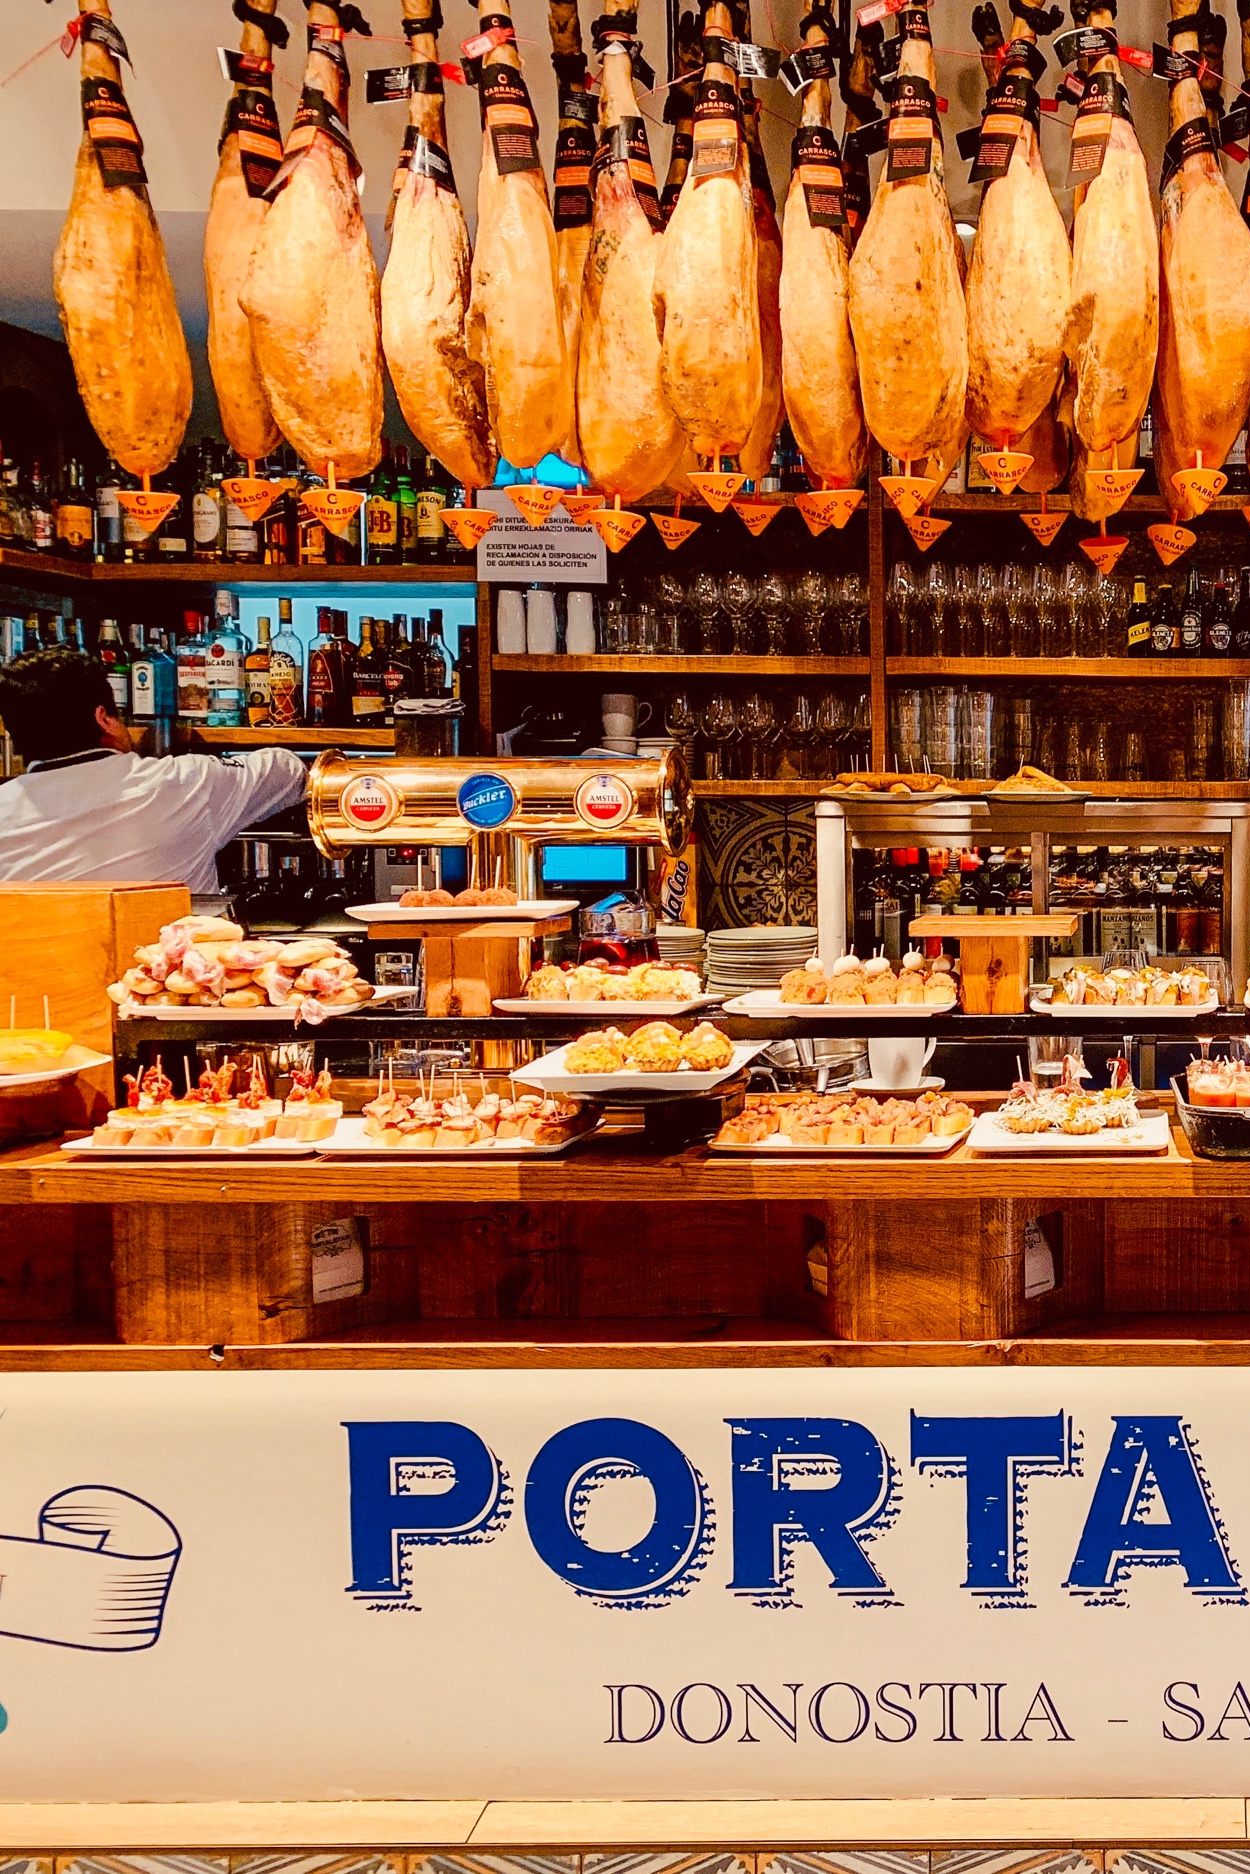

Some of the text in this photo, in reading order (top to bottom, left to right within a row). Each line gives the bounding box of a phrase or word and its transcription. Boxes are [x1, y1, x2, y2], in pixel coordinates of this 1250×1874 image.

[484, 85, 525, 97] CARRASCO
[695, 102, 734, 112] CARRASCO
[891, 99, 931, 109] CARRASCO
[991, 98, 1027, 107] CARRASCO
[799, 148, 837, 157] CARRASCO
[486, 551, 539, 559] RECLAMACIÓN
[549, 552, 597, 560] DISPOSICIÓN
[603, 1682, 1075, 1744] DONOSTIA
